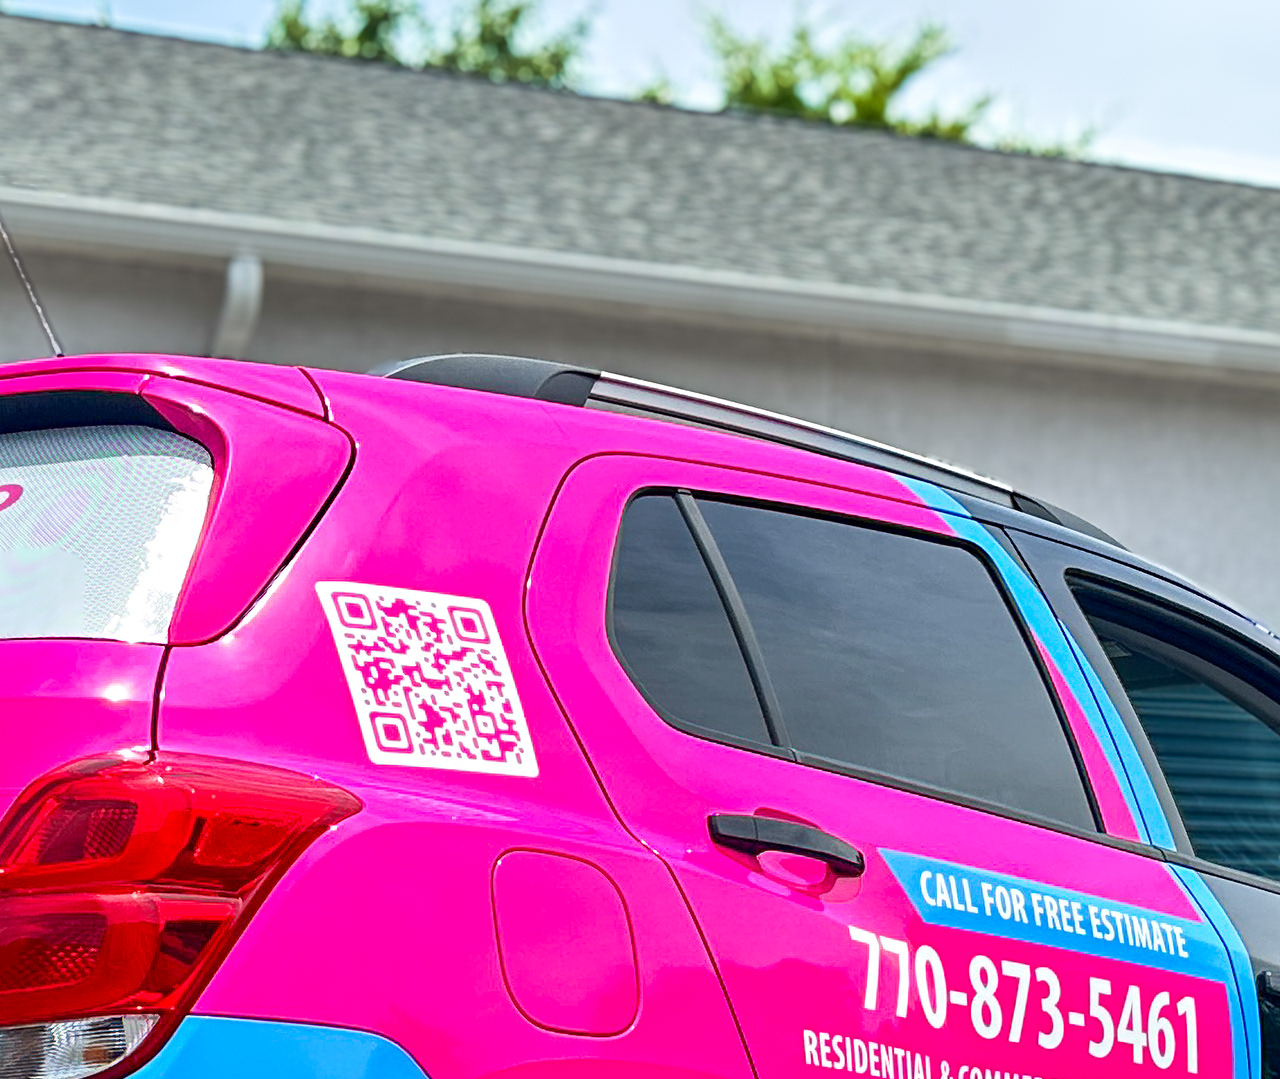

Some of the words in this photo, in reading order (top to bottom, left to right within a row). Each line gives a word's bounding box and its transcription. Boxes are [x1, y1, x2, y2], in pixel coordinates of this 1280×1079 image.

[920, 870, 978, 914] CALL
[981, 881, 1027, 925] FOR
[1033, 892, 1086, 936] FREE
[1091, 905, 1189, 958] ESTIMATE
[848, 925, 1199, 1075] 770-873-5461
